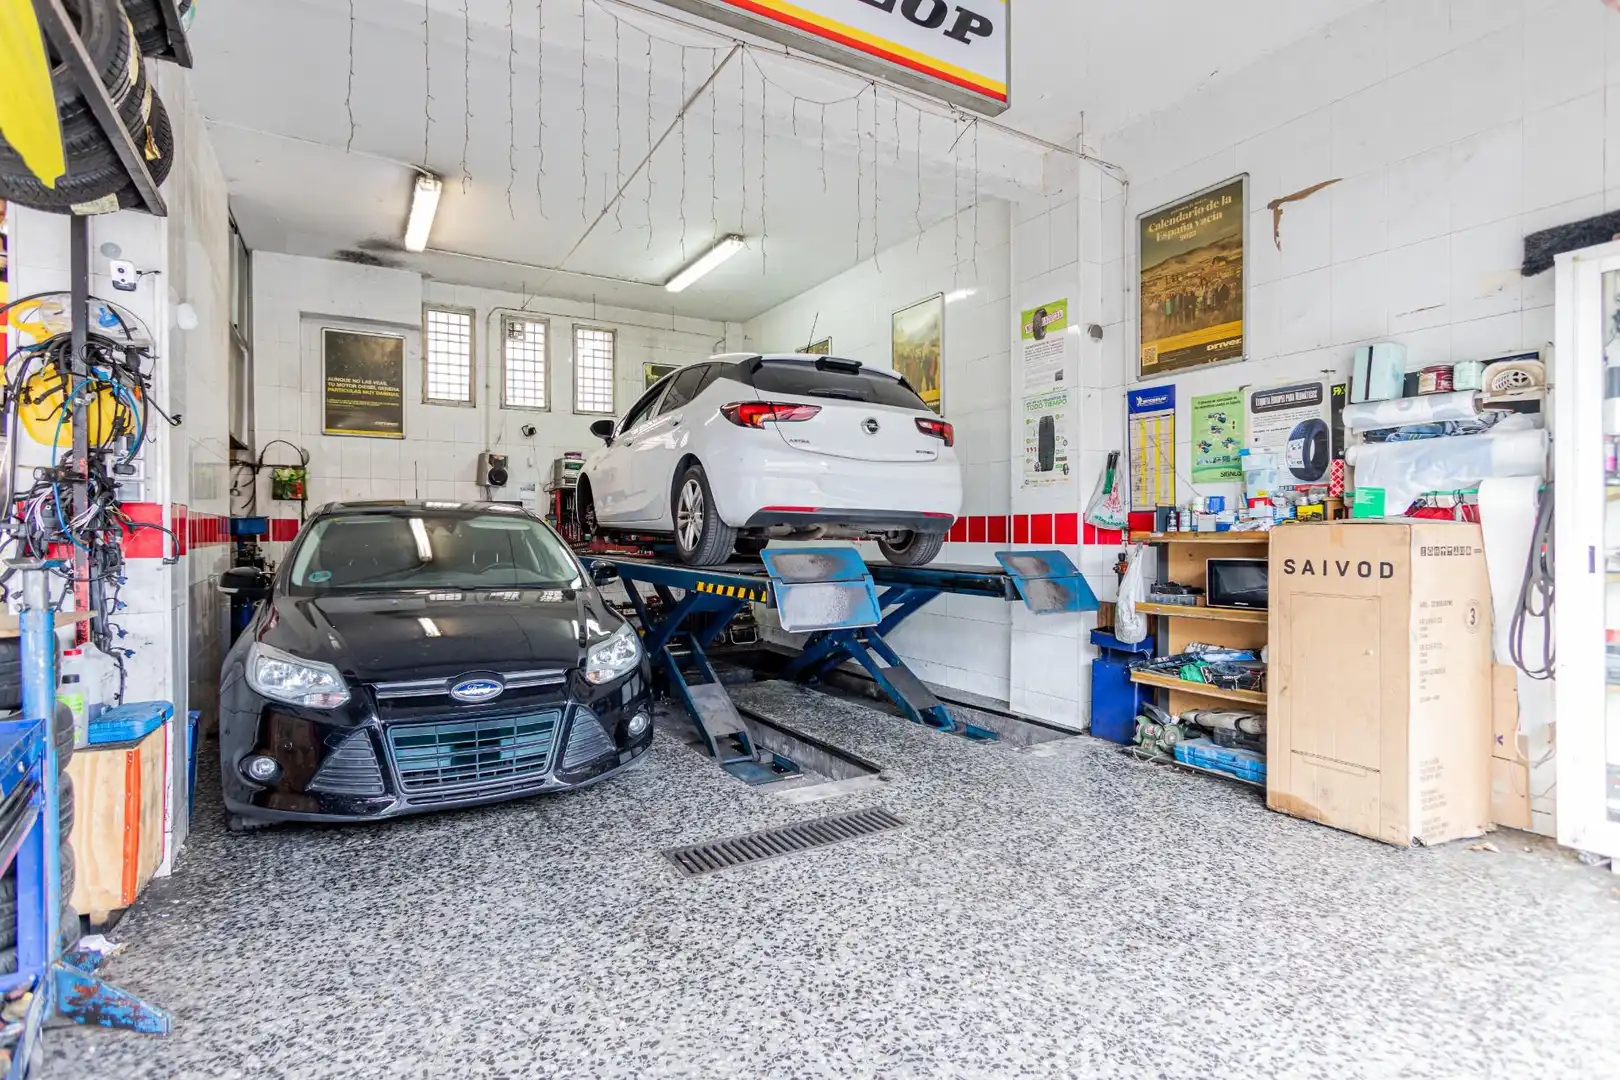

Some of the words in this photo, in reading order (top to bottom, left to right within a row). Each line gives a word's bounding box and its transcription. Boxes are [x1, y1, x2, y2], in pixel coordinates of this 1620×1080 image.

[857, 0, 994, 45] OP
[1148, 206, 1204, 233] Calendario
[1206, 200, 1220, 212] de
[1221, 195, 1232, 206] la
[1156, 222, 1193, 242] España
[1283, 558, 1395, 579] SAIVOD
